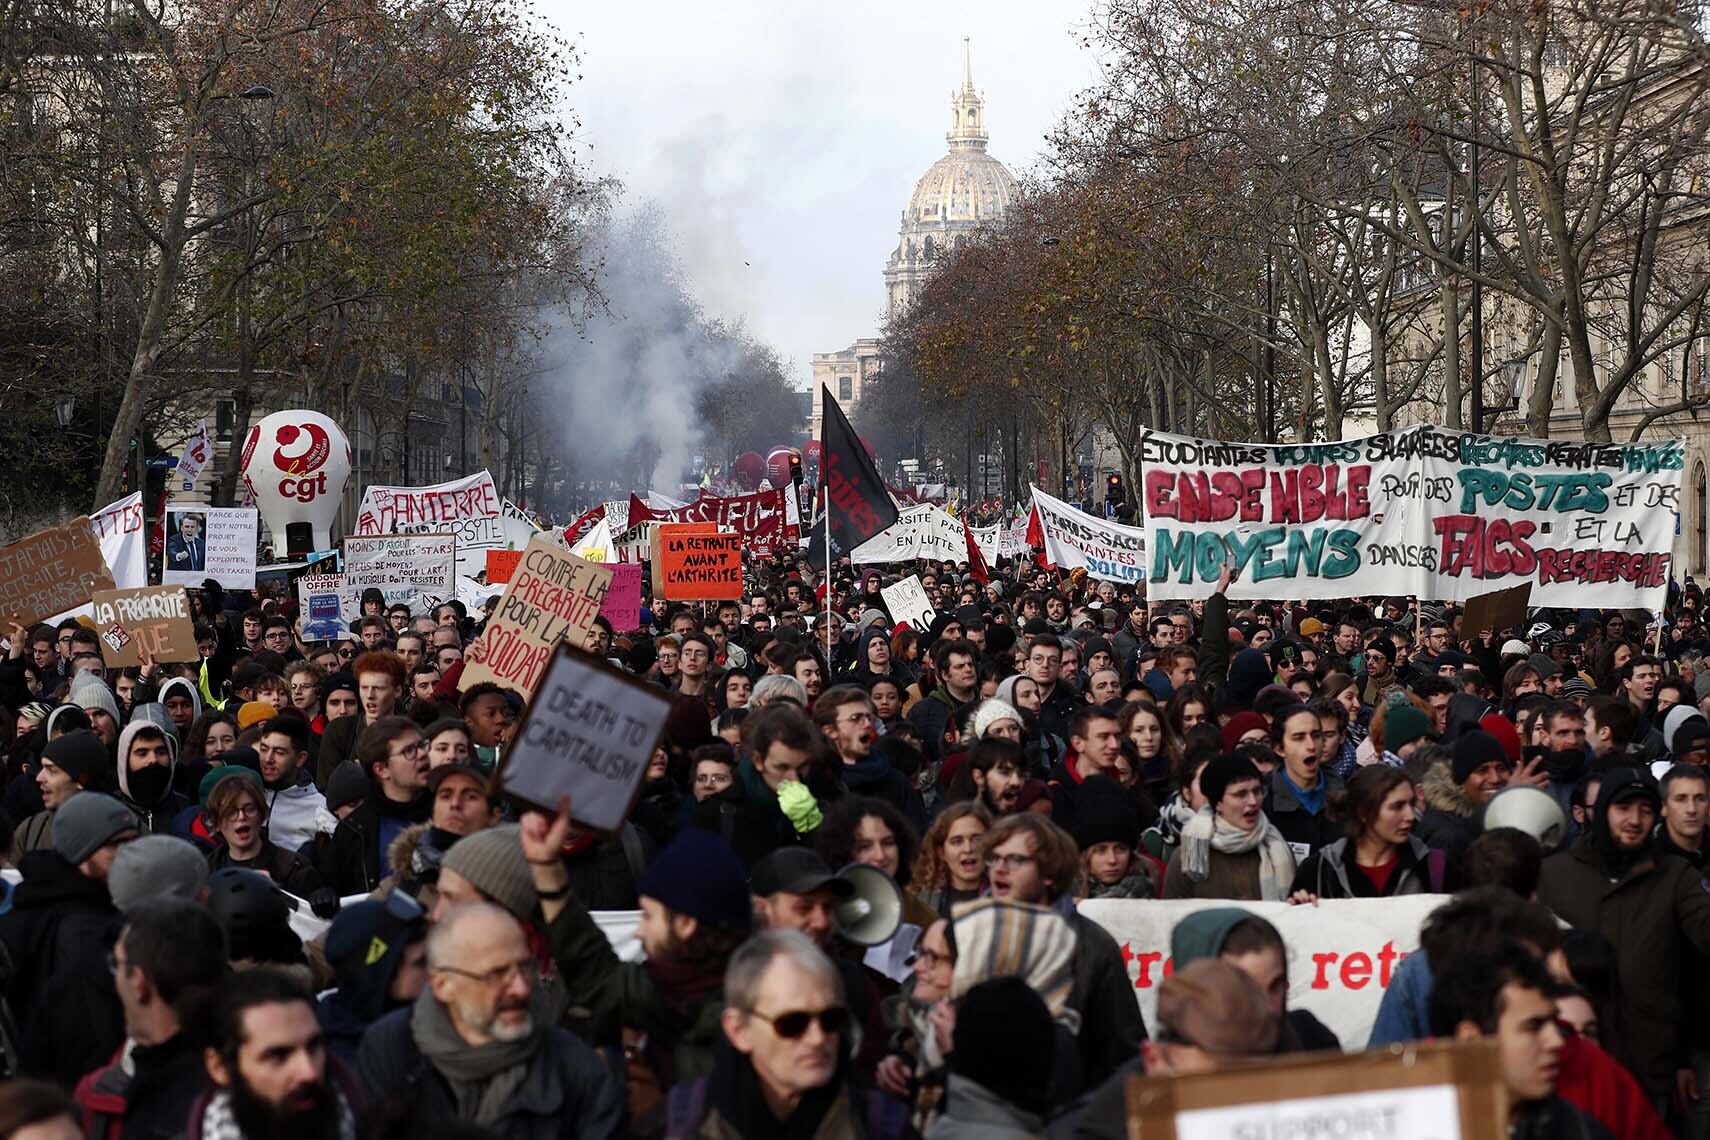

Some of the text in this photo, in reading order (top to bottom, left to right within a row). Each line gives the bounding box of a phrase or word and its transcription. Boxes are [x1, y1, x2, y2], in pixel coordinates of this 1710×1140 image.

[179, 460, 200, 478] attac
[278, 471, 327, 503] cgt
[1145, 463, 1681, 524] ENSEMBLE POUR DES POSTES ET DES
[896, 535, 955, 552] EN LUTTE
[980, 533, 993, 544] 13
[1574, 517, 1643, 545] ET LA
[0, 534, 67, 577] JAMAIS
[378, 538, 411, 550] D'ARGENT
[387, 549, 403, 558] POUR
[668, 539, 684, 552] LA
[687, 537, 741, 551] RETRAITE
[1149, 526, 1362, 584] MOYENS
[1366, 543, 1417, 567] DANS
[1431, 514, 1538, 580] FACS
[348, 561, 413, 572] PLUS DE MOYENS
[683, 553, 729, 567] AVANT
[1536, 548, 1671, 588] RECHERCHE
[306, 581, 340, 590] OFFRE
[347, 576, 356, 586] LA
[358, 573, 386, 585] MUSIQUE
[525, 549, 610, 604] CONTRE LA
[667, 567, 740, 584] L'ARTHRITE
[95, 602, 116, 625] LA
[499, 595, 542, 634] POUR
[539, 615, 570, 645] LA
[129, 623, 175, 657] TUE
[546, 685, 648, 747] DEATH TO
[523, 717, 640, 785] CAPITALISM
[1230, 1104, 1399, 1140] SUPPORT
